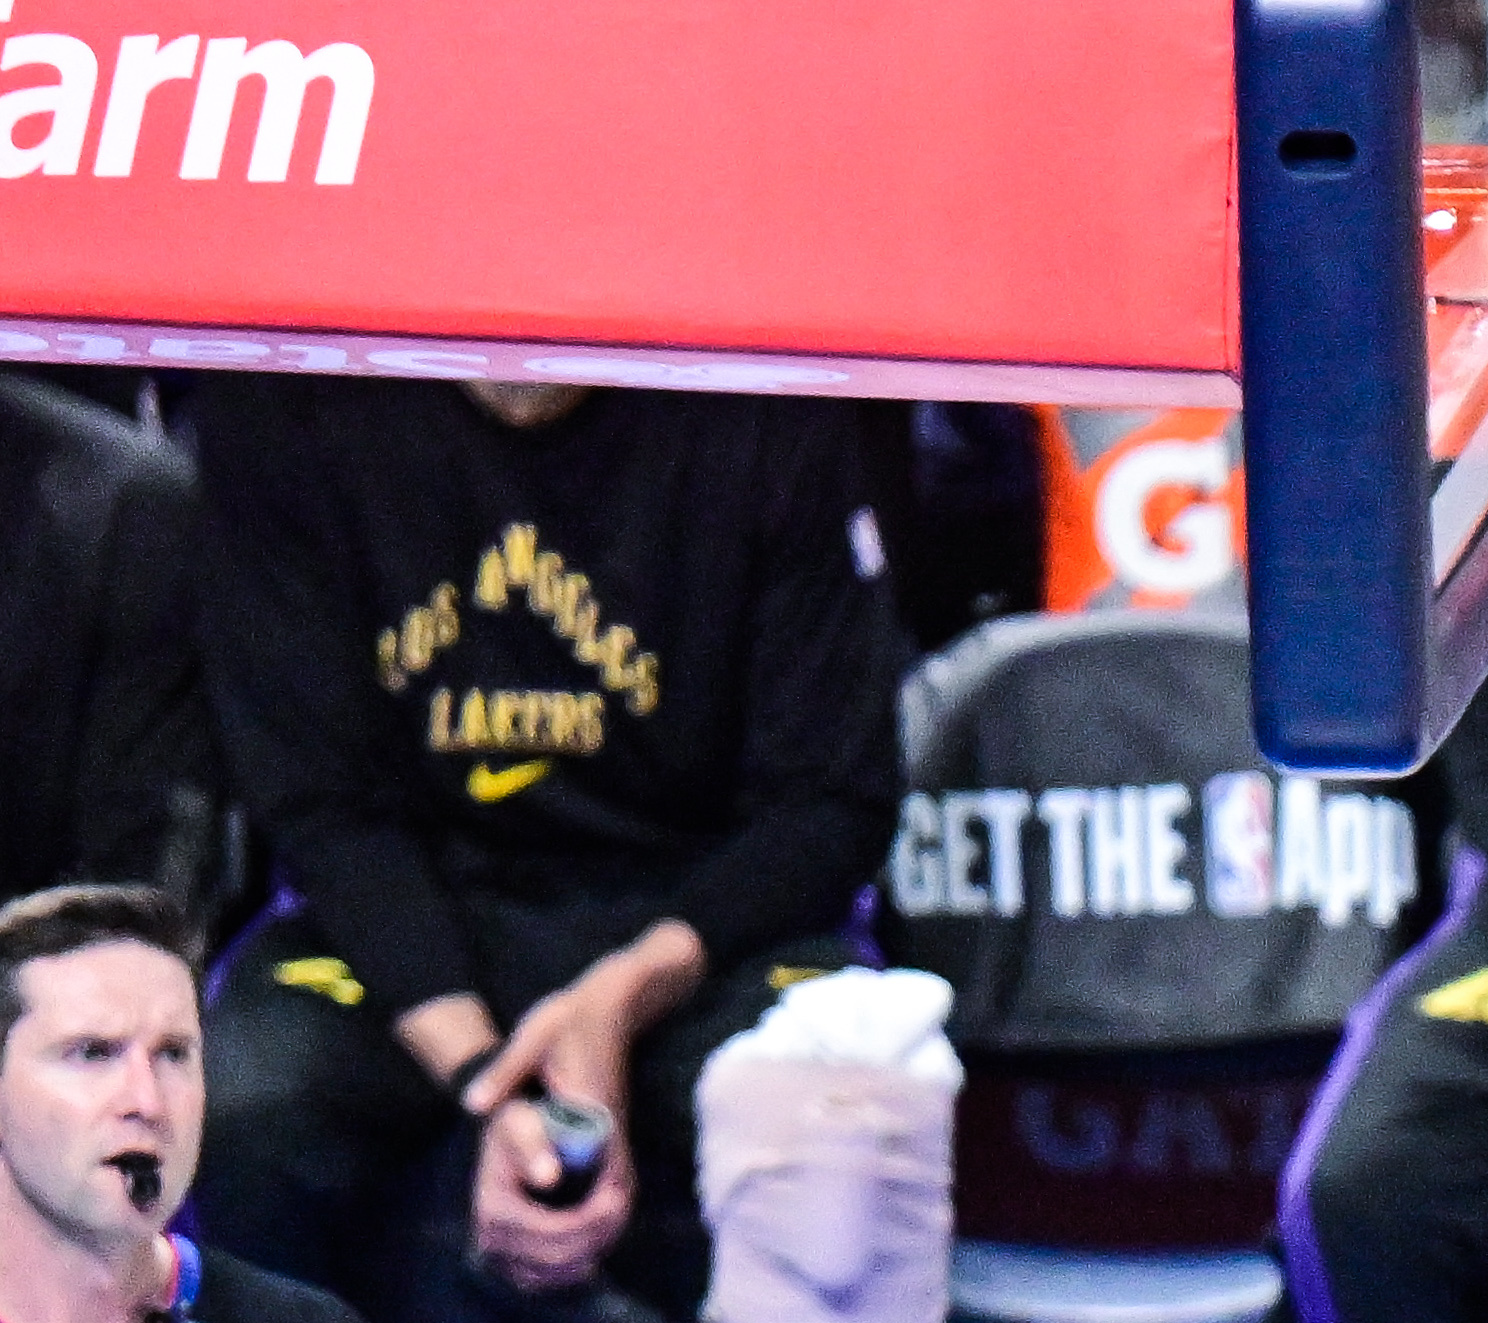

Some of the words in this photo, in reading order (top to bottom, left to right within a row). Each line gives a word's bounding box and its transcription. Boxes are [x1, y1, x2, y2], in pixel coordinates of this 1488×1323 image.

[0, 33, 375, 186] arm
[1094, 437, 1237, 593] G
[888, 784, 1035, 919] GET
[1038, 782, 1196, 918] THE
[1277, 772, 1419, 928] App
